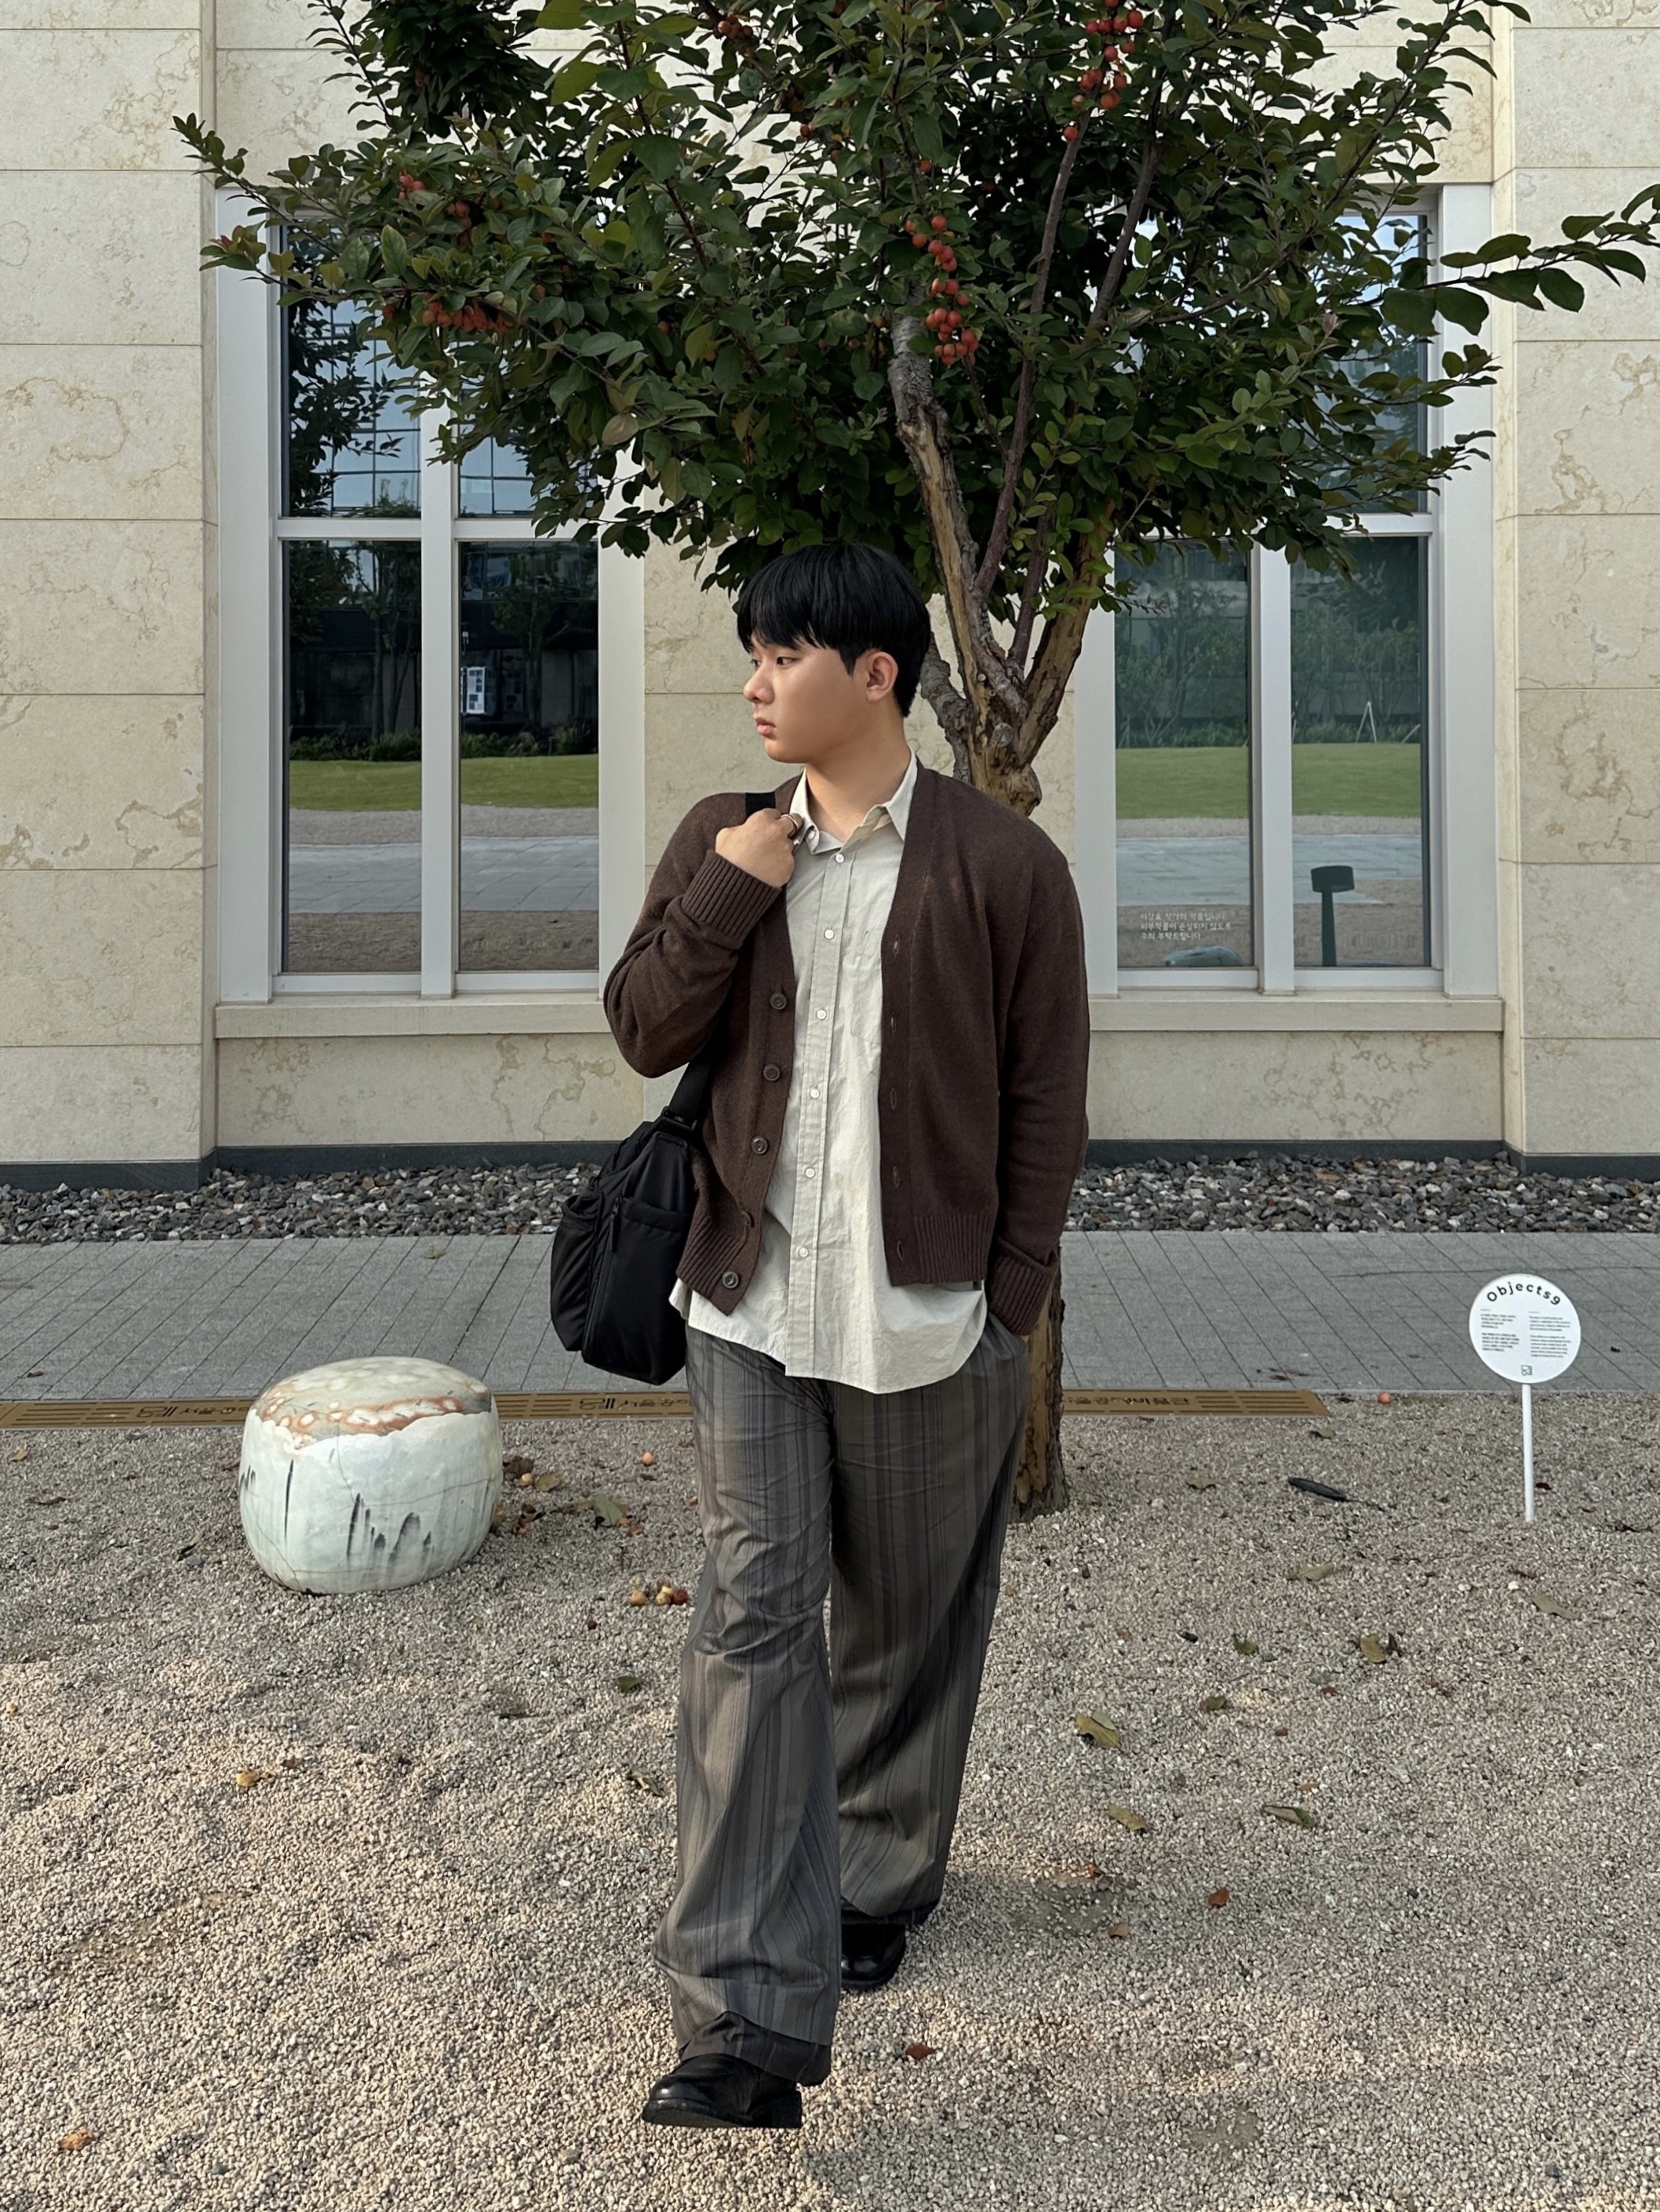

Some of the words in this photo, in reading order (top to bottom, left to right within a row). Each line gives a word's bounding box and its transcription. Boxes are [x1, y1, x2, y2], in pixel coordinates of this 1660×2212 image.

[1165, 912, 1187, 921] 작가의
[1179, 922, 1207, 931] 손상되지
[1141, 932, 1155, 940] 주의
[1157, 932, 1201, 940] 부탁드립니다
[1487, 1282, 1560, 1305] Objects9
